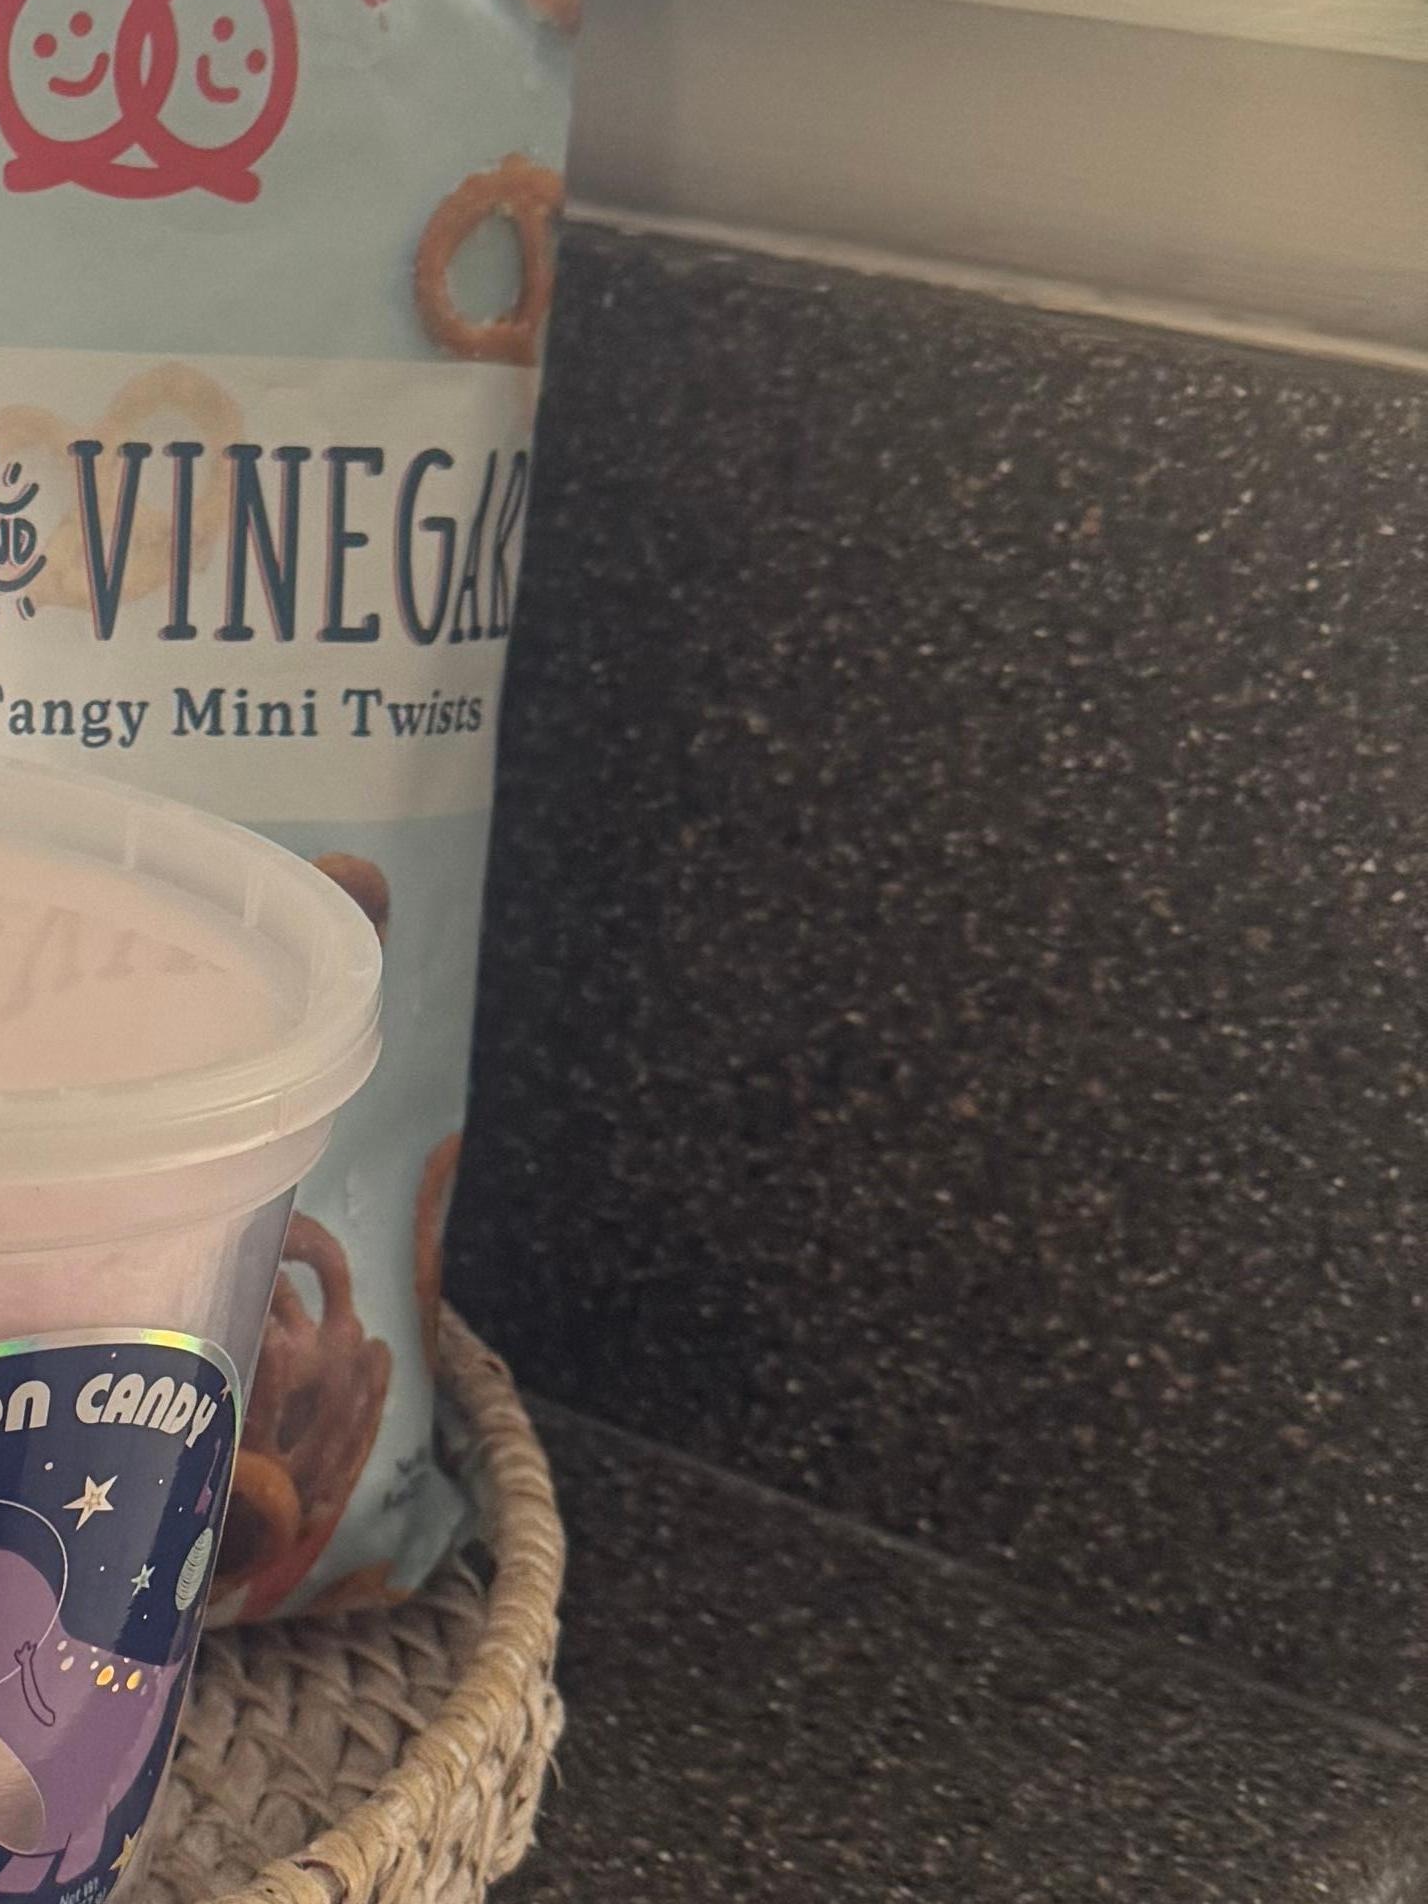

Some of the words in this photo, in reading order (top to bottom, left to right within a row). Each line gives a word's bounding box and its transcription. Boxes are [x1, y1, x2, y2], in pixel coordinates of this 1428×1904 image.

[67, 440, 528, 645] VINEGAR
[172, 688, 317, 736] Mini
[342, 688, 482, 736] Twists
[75, 1373, 218, 1449] CANDY
